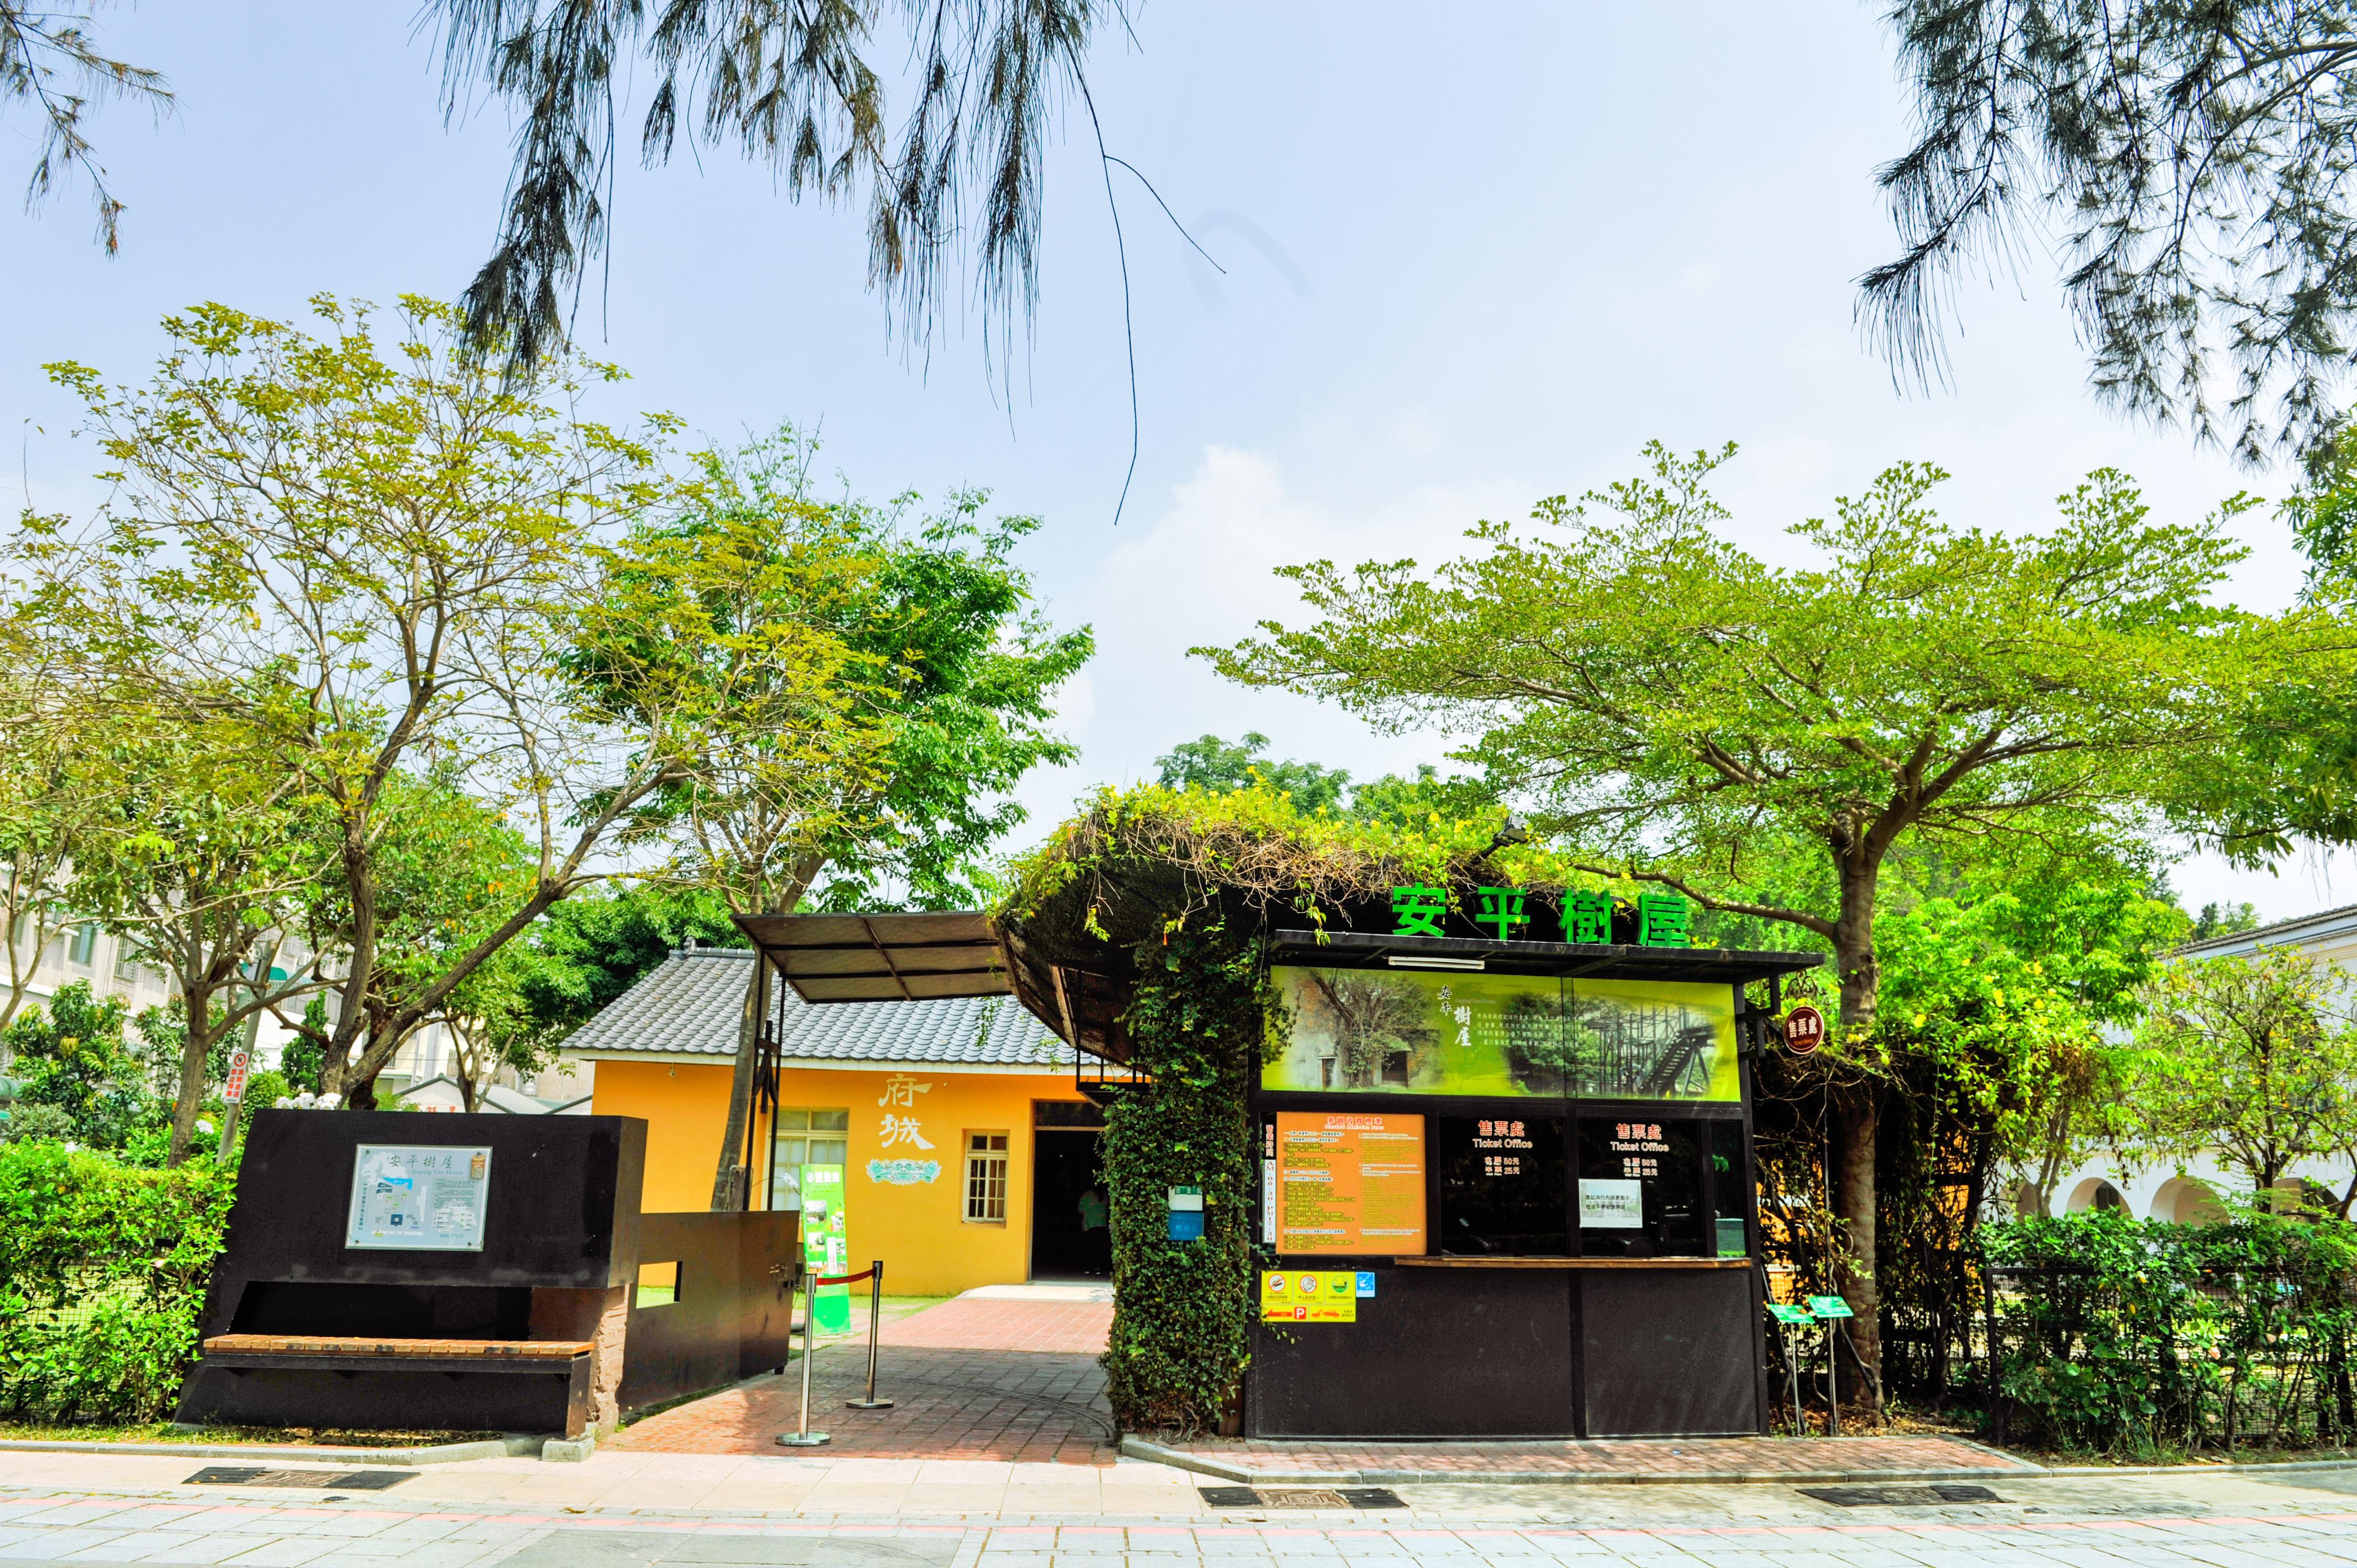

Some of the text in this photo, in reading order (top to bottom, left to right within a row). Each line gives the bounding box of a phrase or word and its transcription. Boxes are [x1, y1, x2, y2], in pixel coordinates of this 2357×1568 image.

[1392, 882, 1691, 947] 安平樹屋
[1437, 984, 1452, 1015] 安平
[1454, 1005, 1471, 1046] 樹屋
[1788, 1017, 1818, 1038] 售票處
[878, 1073, 936, 1150] 府城
[1478, 1120, 1525, 1137] 售票處
[1616, 1123, 1662, 1140] 售票處
[1473, 1138, 1533, 1149] Ticket Office
[1610, 1141, 1669, 1152] Ticket Office
[389, 1154, 452, 1169] 安平樹屋
[1296, 1308, 1305, 1319] P
